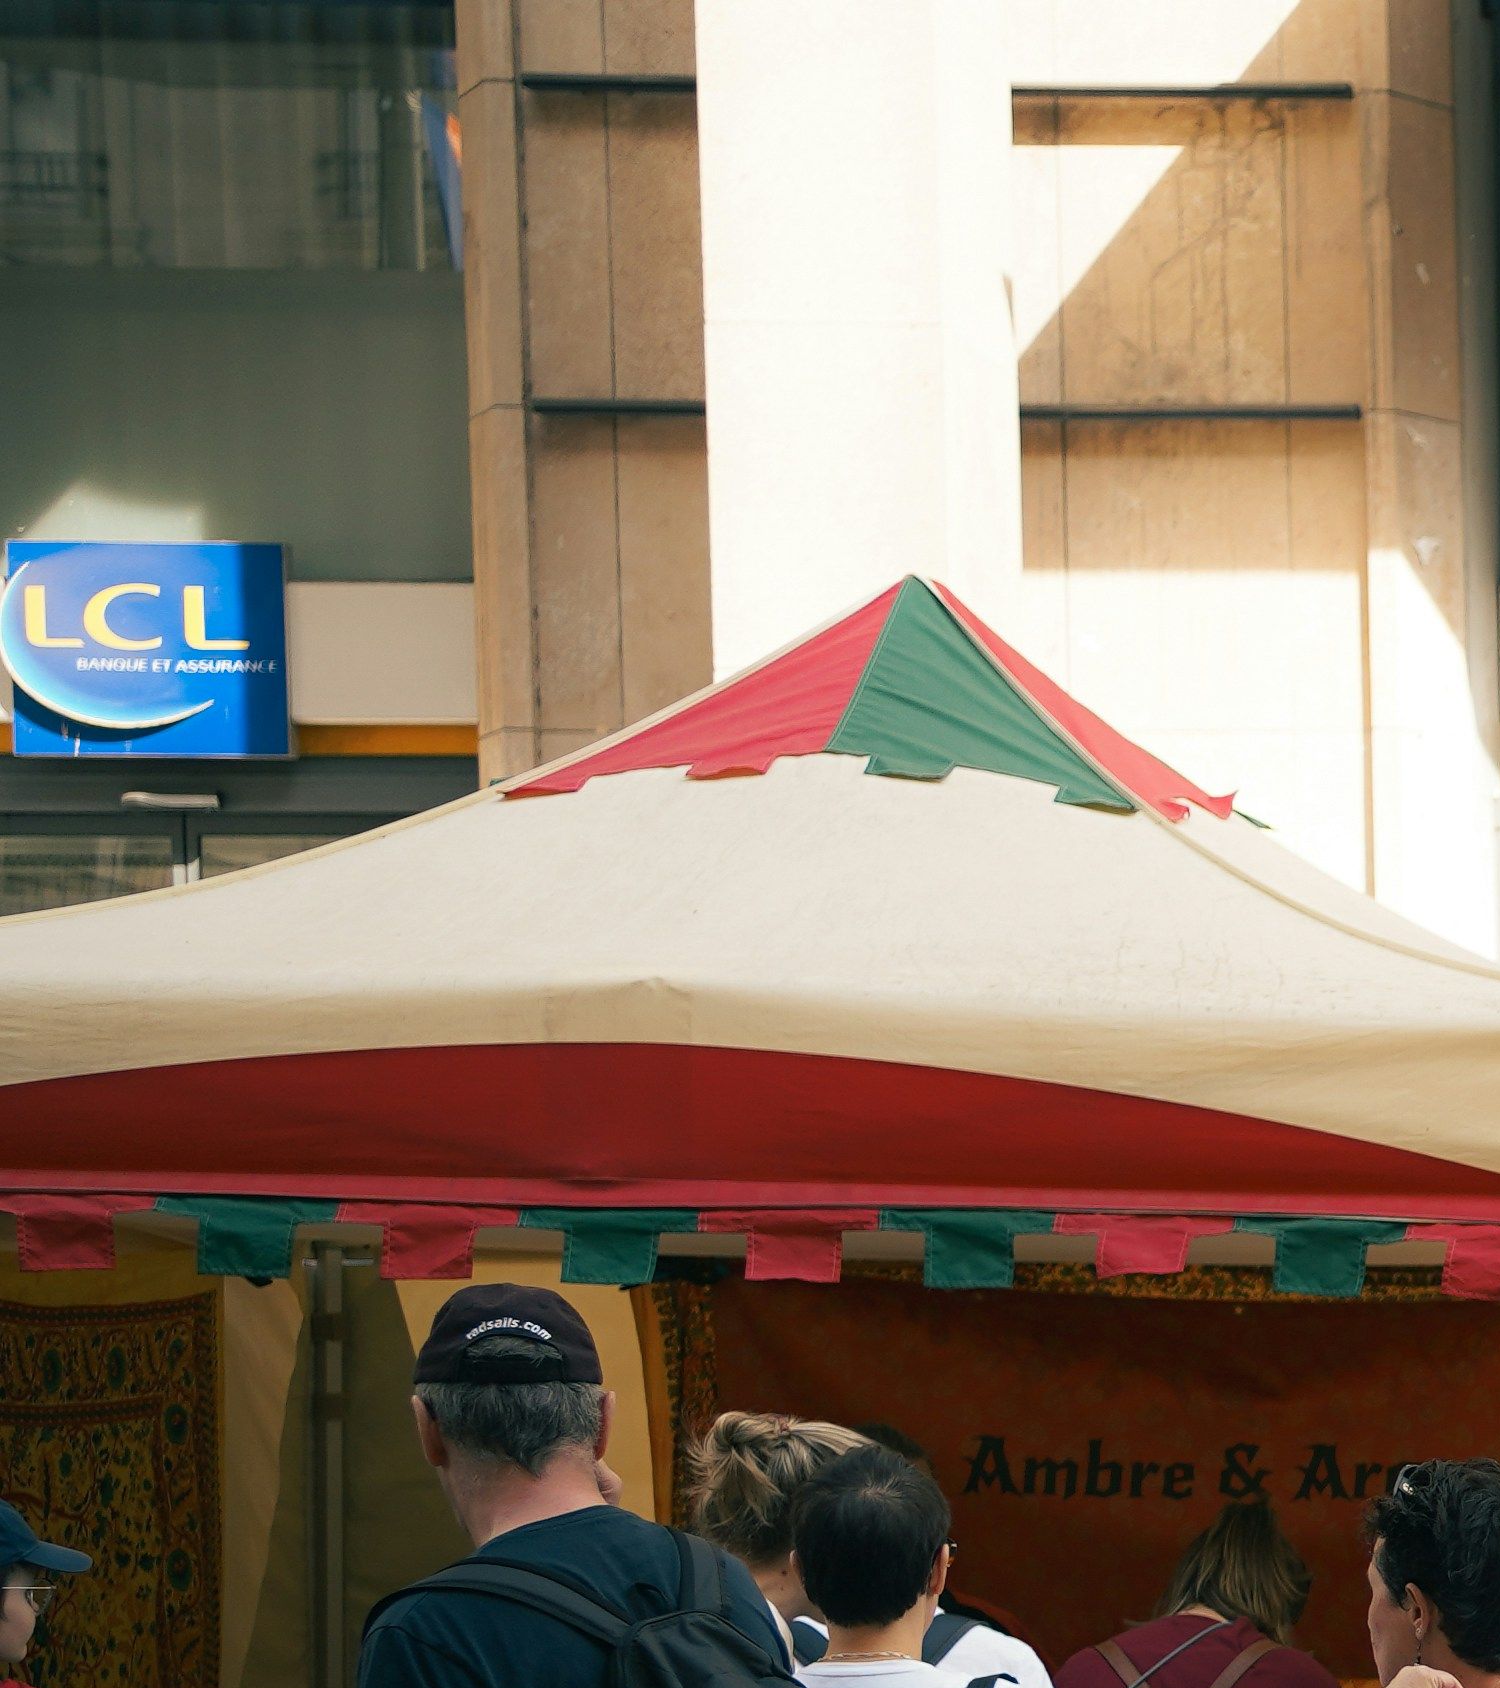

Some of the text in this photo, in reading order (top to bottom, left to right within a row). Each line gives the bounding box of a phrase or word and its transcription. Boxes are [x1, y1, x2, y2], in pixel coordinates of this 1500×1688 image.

[24, 583, 250, 651] LCL
[76, 656, 277, 674] BANQUE ET ASSURANCE
[961, 1434, 1195, 1499] Ambre
[1219, 1442, 1273, 1498] &
